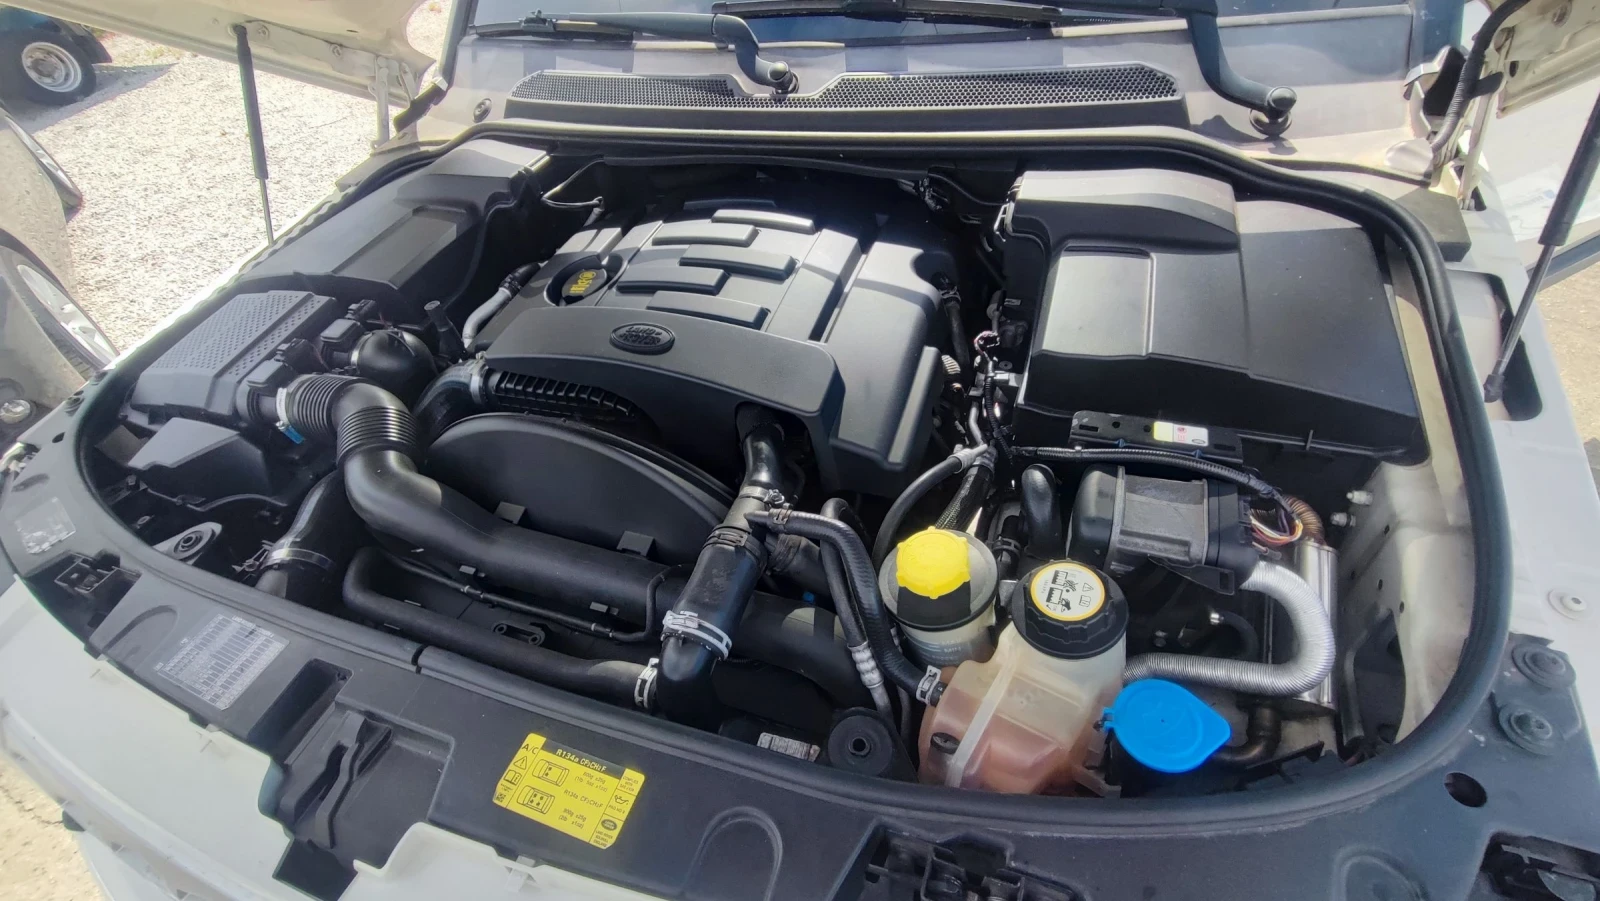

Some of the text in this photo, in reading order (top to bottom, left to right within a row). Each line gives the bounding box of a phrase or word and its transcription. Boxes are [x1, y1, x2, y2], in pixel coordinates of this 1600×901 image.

[521, 743, 539, 755] A/C
[556, 749, 579, 763] R134a
[563, 789, 579, 799] R134a
